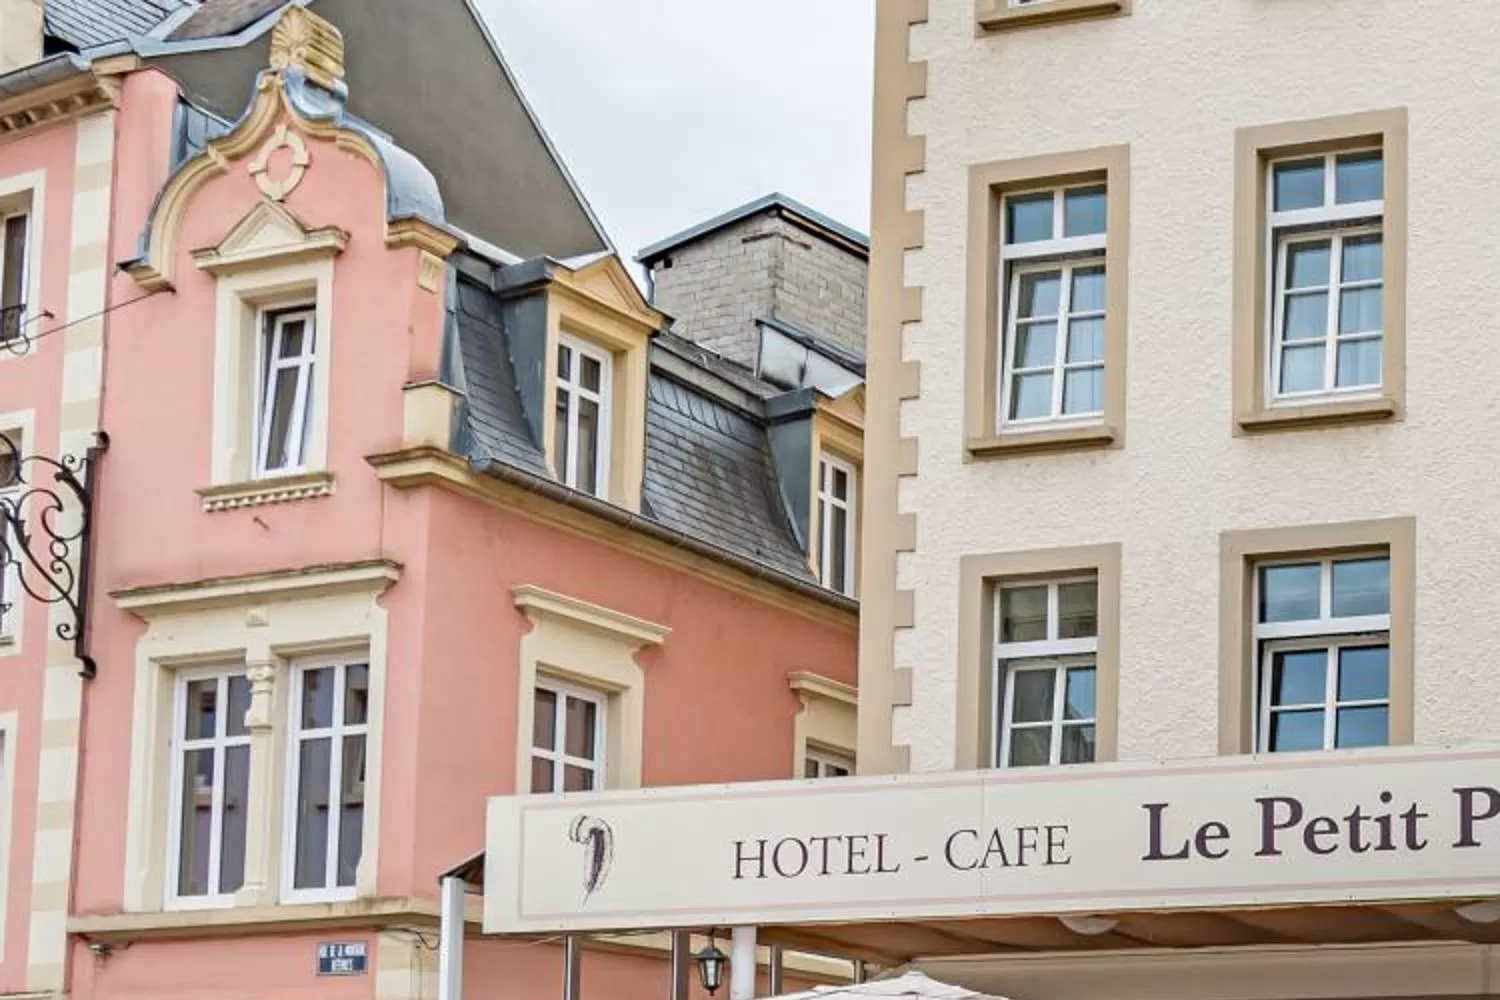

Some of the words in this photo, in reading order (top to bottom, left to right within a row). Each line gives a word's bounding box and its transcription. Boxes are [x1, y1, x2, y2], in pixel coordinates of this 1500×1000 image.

[732, 833, 901, 880] HOTEL
[944, 824, 1072, 871] CAFE
[1141, 802, 1231, 862] Le
[1253, 790, 1429, 857] Petit
